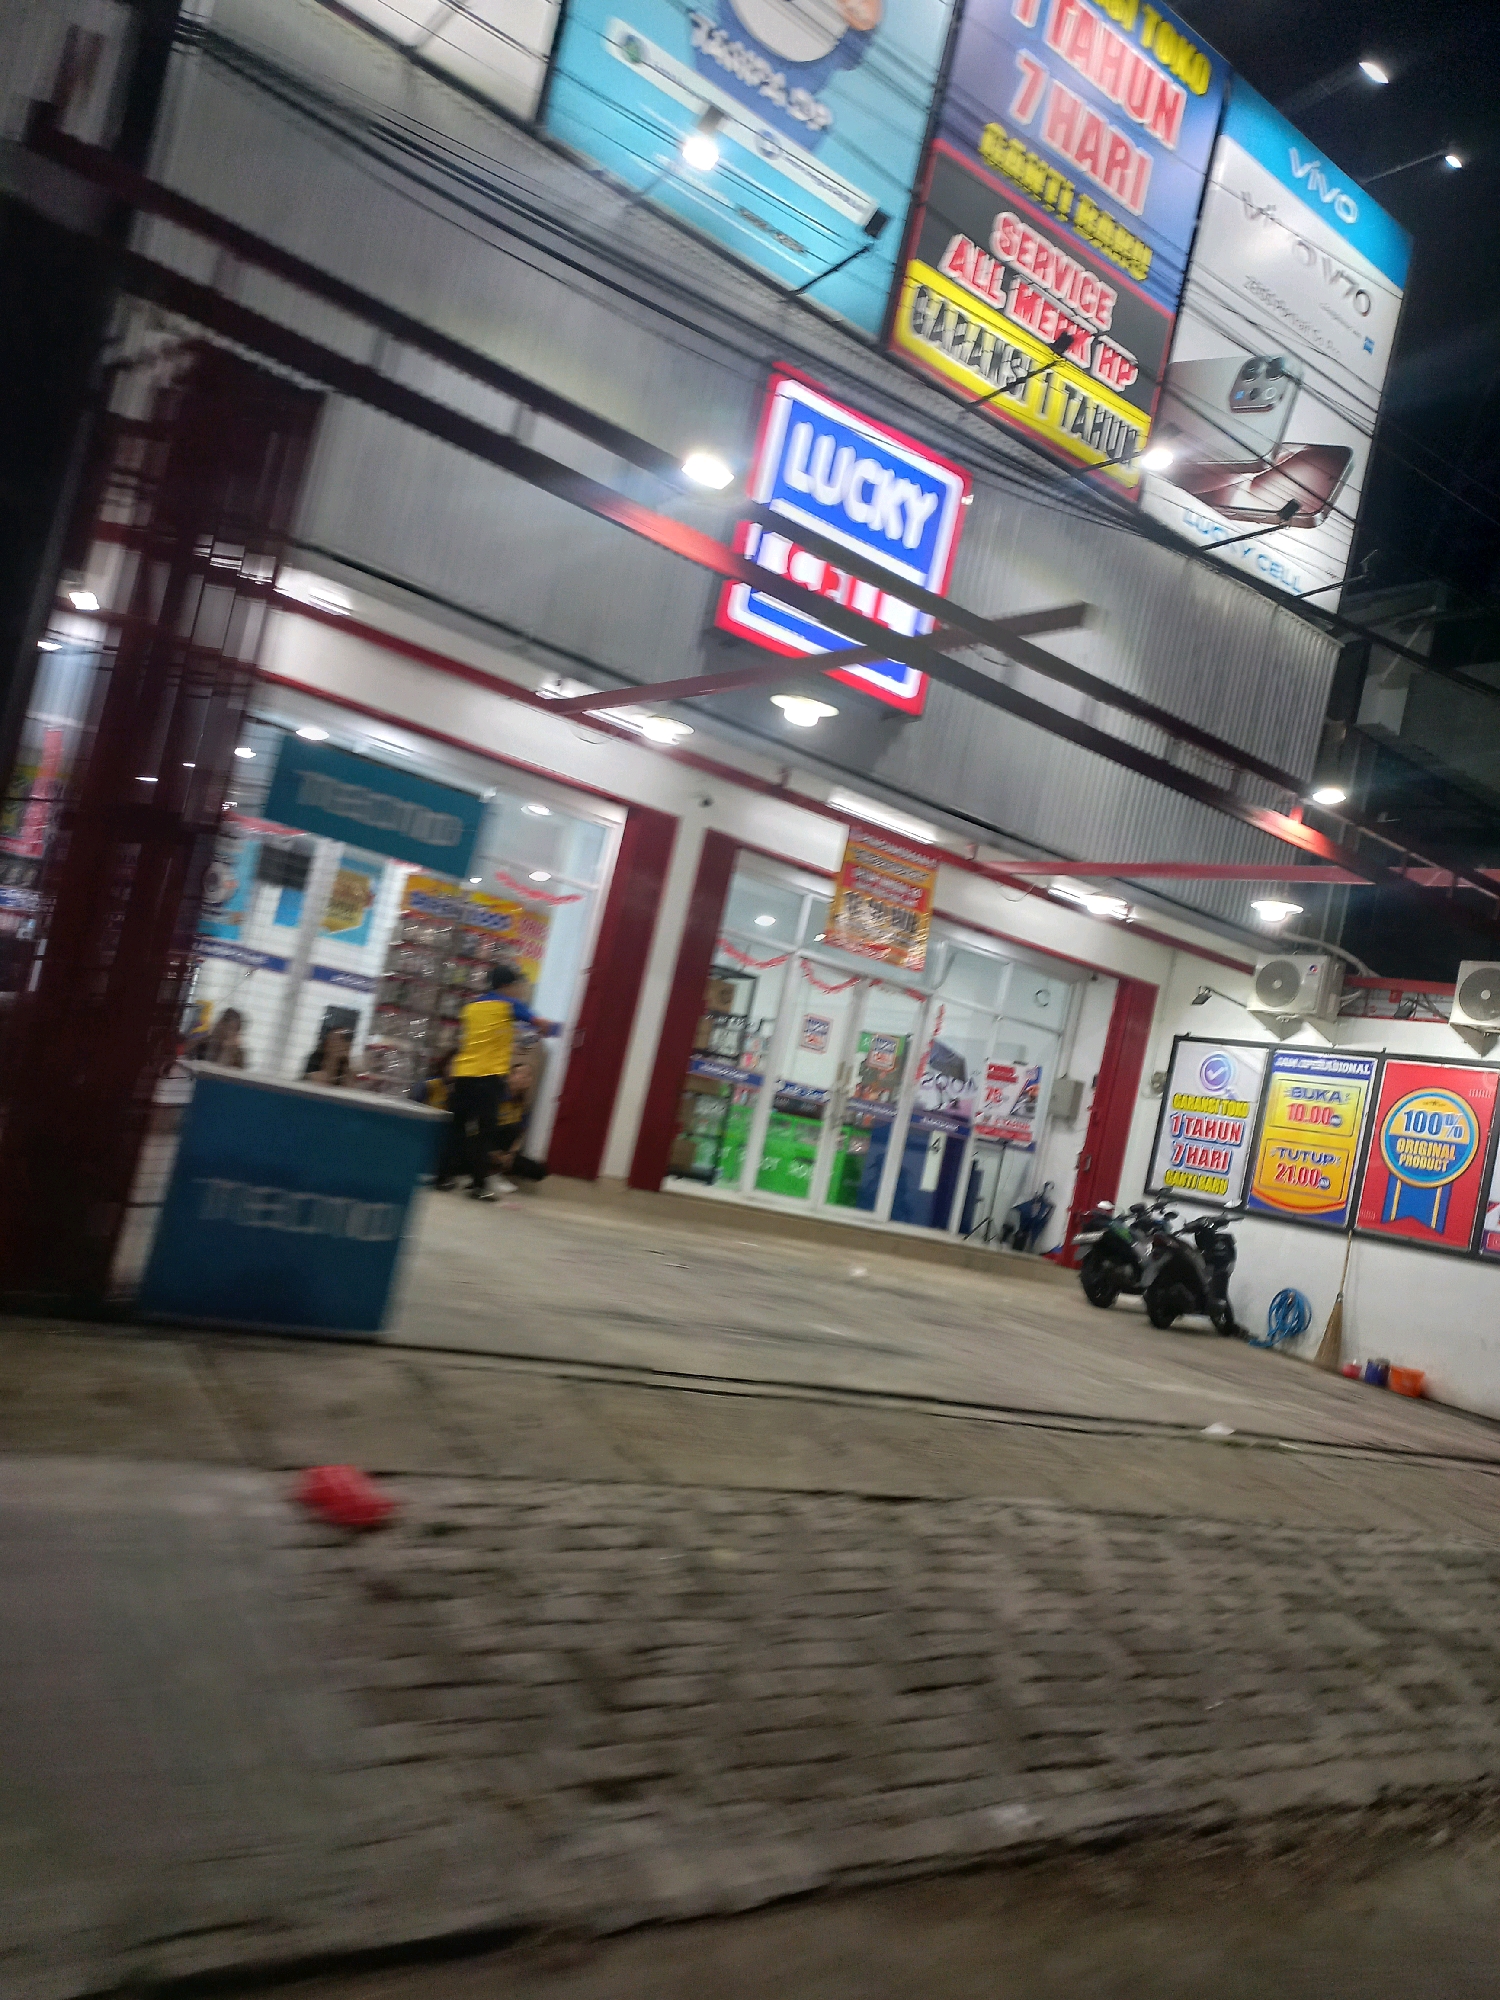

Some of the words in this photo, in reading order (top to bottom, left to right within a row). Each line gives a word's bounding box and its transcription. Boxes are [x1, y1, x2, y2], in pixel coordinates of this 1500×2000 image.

[1044, 0, 1188, 149] TAHUN
[1010, 49, 1047, 125] 7
[1042, 80, 1153, 216] HARI
[939, 234, 1007, 308] ALL
[989, 211, 1117, 331] SERVICE
[784, 421, 938, 550] LUCKY
[1171, 1114, 1182, 1137] 1
[1183, 1115, 1244, 1145] TAHUN
[1395, 1137, 1457, 1161] ORIGINAL
[1403, 1109, 1464, 1140] 100%
[1173, 1142, 1185, 1166] 7
[1185, 1143, 1232, 1173] HARI
[1398, 1153, 1451, 1173] PRODUCT
